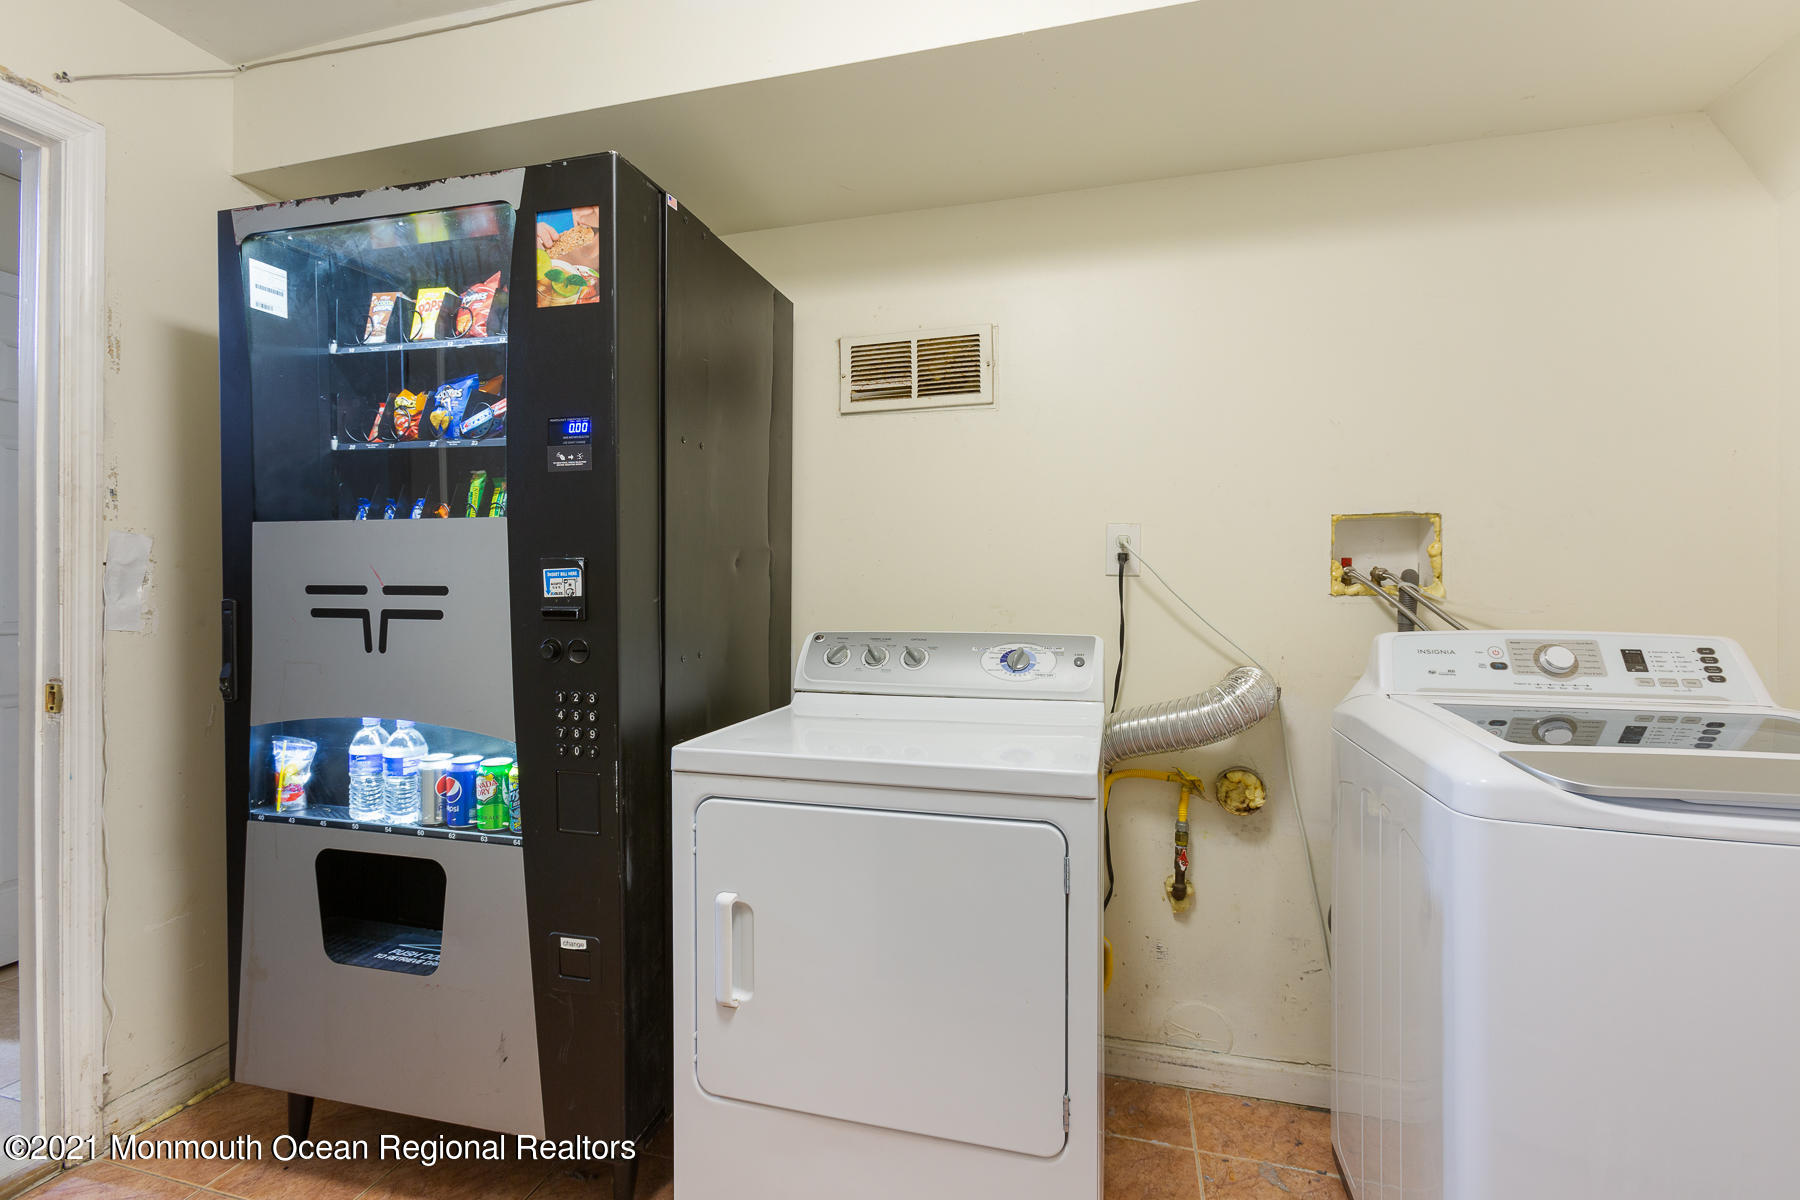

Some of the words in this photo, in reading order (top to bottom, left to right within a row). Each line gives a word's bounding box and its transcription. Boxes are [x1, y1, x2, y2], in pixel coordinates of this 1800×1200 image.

[558, 693, 562, 702] 1
[573, 693, 579, 702] 2
[589, 694, 595, 703] 3
[558, 710, 564, 720] 4
[574, 711, 579, 720] 5
[589, 712, 595, 721] 6
[559, 728, 564, 738] 7
[574, 729, 580, 738] 8
[590, 729, 596, 739] 9
[574, 746, 580, 756] 0
[388, 948, 424, 958] PUSH
